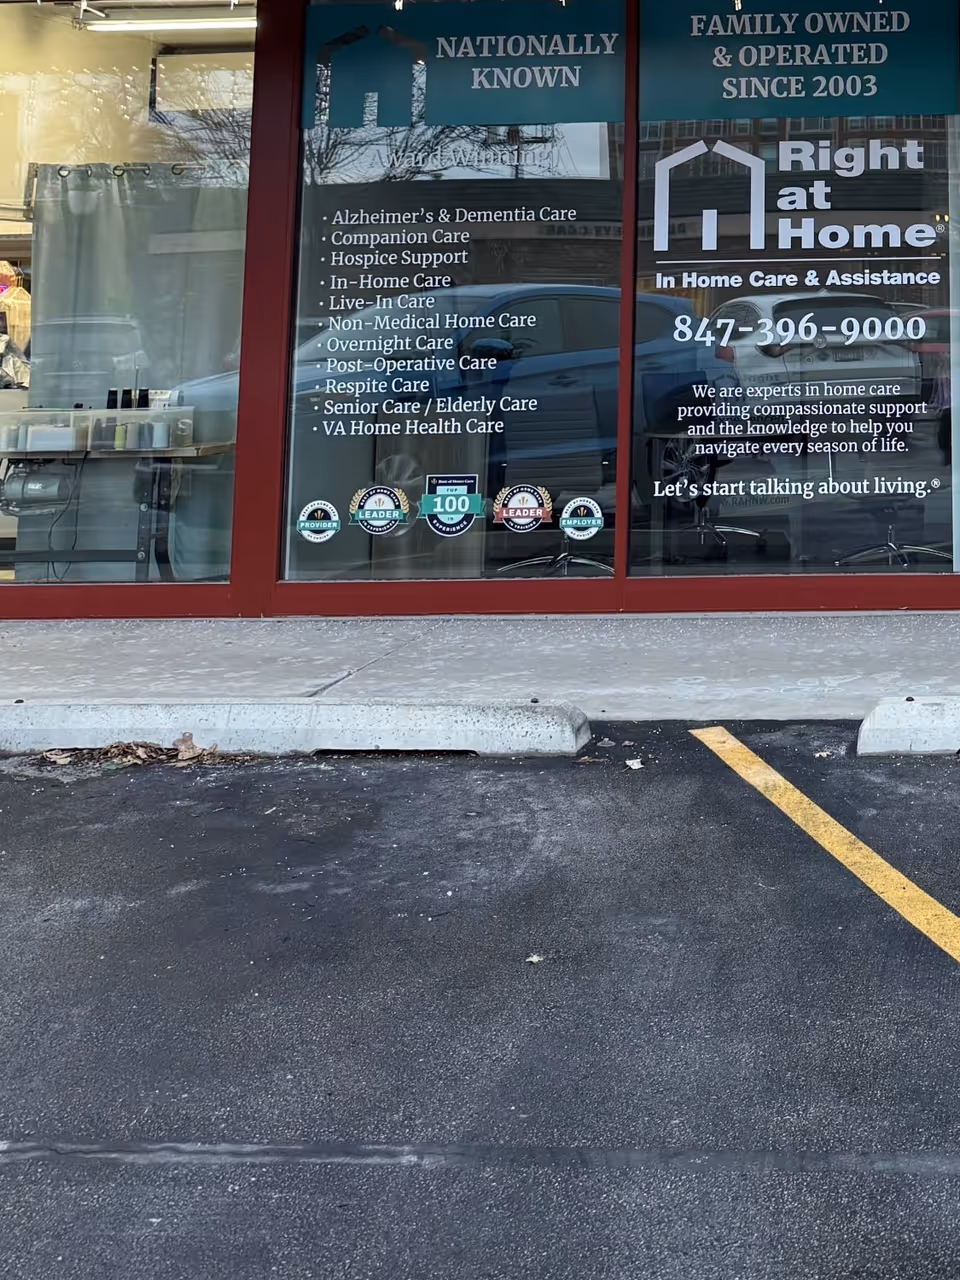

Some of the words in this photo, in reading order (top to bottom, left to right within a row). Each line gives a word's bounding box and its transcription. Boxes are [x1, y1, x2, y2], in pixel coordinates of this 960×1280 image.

[691, 13, 799, 36] FAMILY
[805, 11, 910, 33] OWNED
[436, 33, 619, 57] NATIONALLY
[713, 46, 732, 67] &
[739, 43, 887, 66] OPERATED
[472, 66, 581, 88] KNOWN
[723, 77, 805, 98] SINCE
[813, 75, 877, 96] 2003
[368, 146, 443, 169] Award
[448, 144, 555, 170] Winning
[779, 139, 924, 177] Right
[777, 181, 831, 210] at
[438, 209, 450, 222] &
[455, 207, 535, 222] Dementia
[540, 207, 576, 220] Care
[332, 230, 428, 248] Companion
[433, 229, 469, 243] Care
[331, 251, 397, 269] Hospice
[401, 250, 468, 268] Support
[331, 275, 409, 289] In-Home
[414, 273, 451, 287] Care
[656, 273, 675, 288] In
[683, 272, 742, 288] Home
[749, 271, 798, 287] Care
[805, 270, 820, 286] &
[826, 269, 940, 285] Assistance
[329, 295, 392, 310] Live-In
[397, 294, 435, 308] Care
[328, 313, 440, 330] Non-Medical
[445, 314, 495, 328] Home
[499, 313, 536, 327] Care
[673, 313, 926, 346] 847-396-9000
[327, 335, 411, 355] Overnight
[416, 336, 453, 350] Care
[327, 357, 455, 375] Post-Operative
[459, 356, 496, 370] Care
[325, 378, 387, 397] Respite
[392, 378, 429, 392] Care
[692, 385, 715, 397] We
[719, 387, 742, 397] are
[746, 383, 804, 400] experts
[805, 386, 819, 396] in
[823, 384, 865, 397] home
[869, 385, 901, 396] care
[324, 399, 378, 414] Senior
[383, 399, 420, 413] Care
[436, 396, 496, 415] Elderly
[500, 397, 537, 411] Care
[678, 402, 750, 420] providing
[754, 402, 865, 419] compassionate
[869, 402, 927, 417] support
[323, 421, 346, 435] VA
[351, 421, 400, 435] Home
[405, 418, 461, 434] Health
[466, 419, 503, 433] Care
[688, 421, 715, 435] and
[720, 421, 743, 435] the
[747, 420, 827, 437] knowledge
[831, 421, 846, 433] to
[850, 419, 882, 436] help
[886, 422, 913, 436] you
[695, 440, 759, 458] navigate
[763, 443, 803, 456] every
[807, 442, 858, 456] season
[862, 438, 878, 451] of
[881, 438, 908, 451] life.
[702, 480, 746, 496] start
[750, 479, 814, 498] talking
[818, 477, 869, 494] about
[433, 496, 469, 512] 100
[359, 510, 399, 518] LEADER
[433, 520, 467, 531] EXPERIENCE
